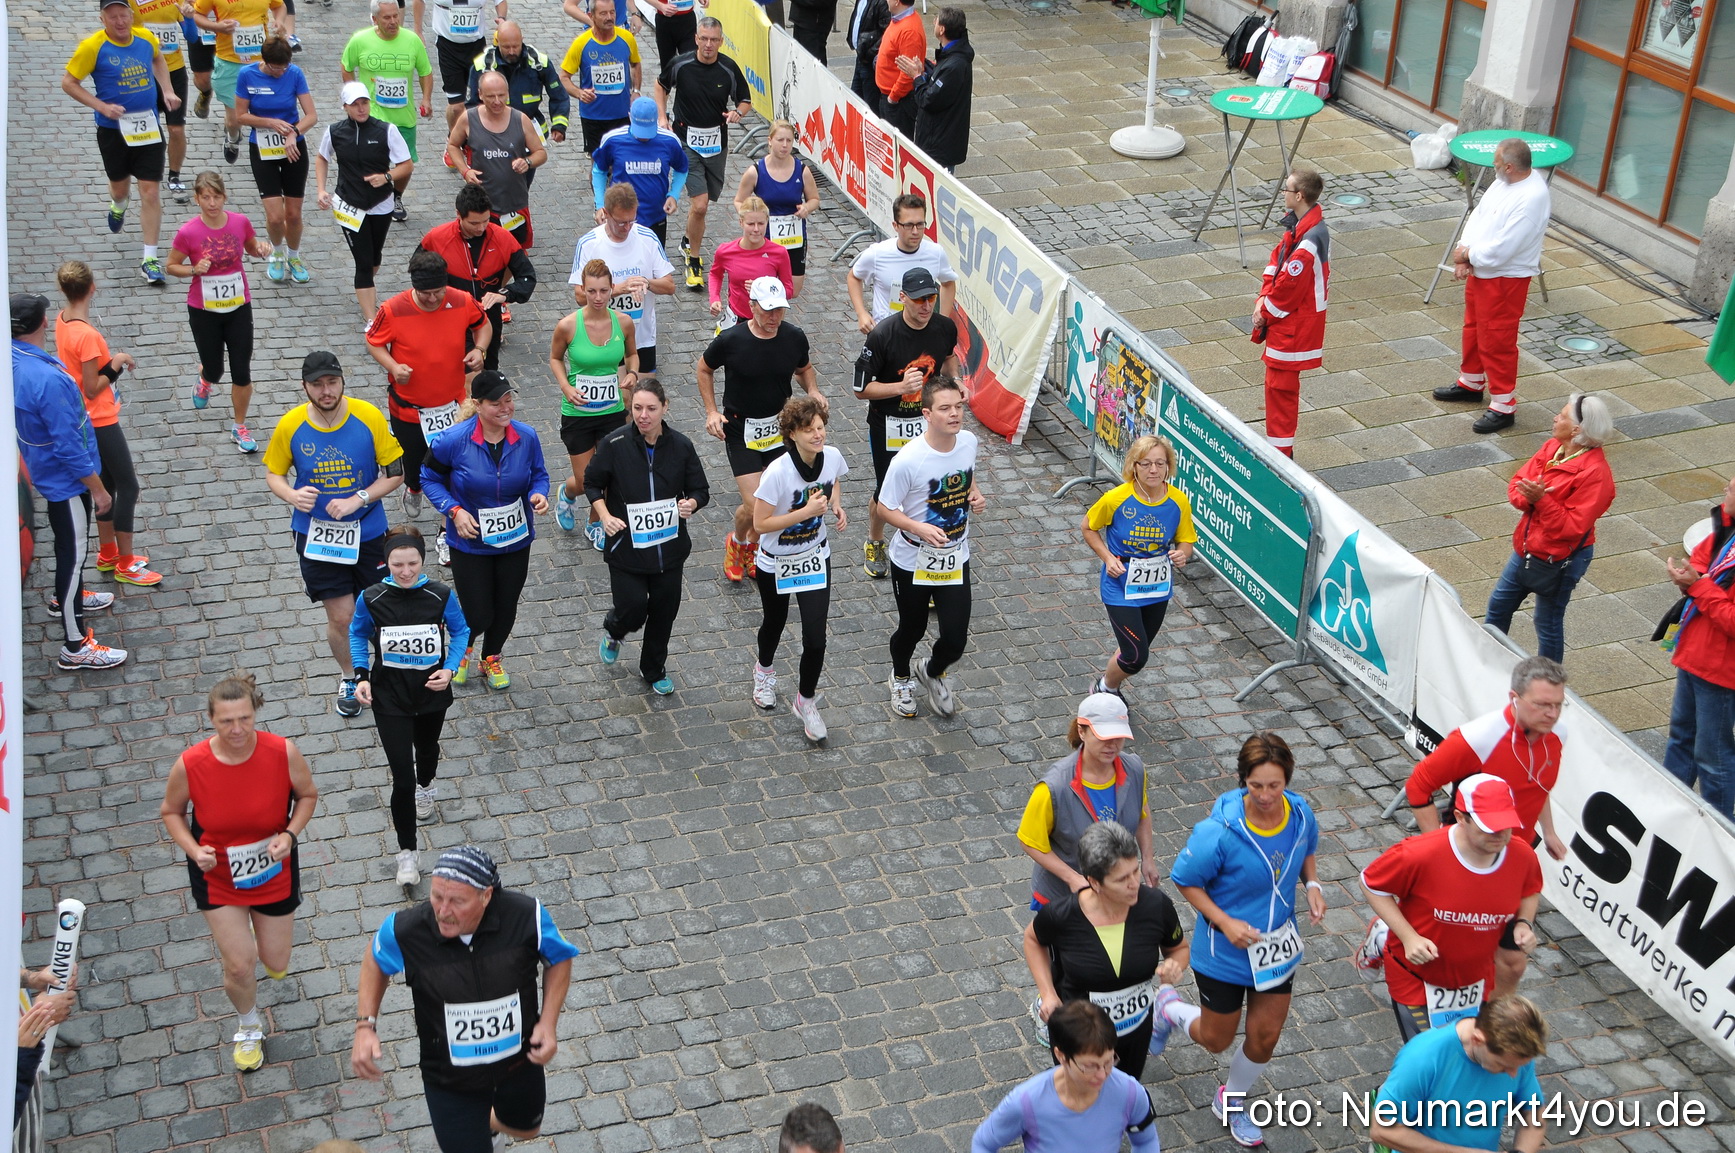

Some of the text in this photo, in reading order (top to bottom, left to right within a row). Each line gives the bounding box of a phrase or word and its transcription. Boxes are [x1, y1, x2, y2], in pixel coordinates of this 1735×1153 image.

[139, 4, 158, 15] MAX
[453, 15, 479, 26] 2077
[237, 34, 264, 46] 2545
[595, 71, 622, 84] 2264
[378, 84, 405, 97] 2323
[132, 120, 147, 133] 73
[691, 134, 719, 147] 2577
[625, 161, 662, 171] HUBER
[845, 149, 866, 190] Braun
[778, 223, 796, 237] 271
[212, 283, 236, 299] 121
[581, 384, 615, 400] 2070
[896, 422, 923, 437] 193
[755, 438, 776, 448] Werner
[1183, 413, 1252, 480] Event-Leit-Systeme
[1193, 466, 1252, 530] Sicherheit
[486, 510, 522, 534] 2504
[634, 510, 673, 531] 2697
[1196, 493, 1234, 543] Event!
[313, 526, 355, 546] 2620
[497, 531, 518, 542] Marion
[647, 532, 664, 541] Britta
[321, 547, 342, 557] Ronny
[781, 556, 822, 578] 2568
[926, 554, 956, 571] 219
[926, 572, 952, 580] Andreas
[1132, 565, 1168, 584] 2113
[1205, 541, 1223, 566] Line:
[1223, 558, 1246, 587] 09181
[1247, 581, 1267, 606] 6352
[793, 578, 811, 586] Karin
[402, 629, 431, 637] Neumarkt
[387, 637, 436, 655] 2336
[399, 656, 424, 665] Selina
[1312, 626, 1388, 692] Gebäude Service GmbH
[251, 873, 270, 886] Gabi
[1559, 865, 1709, 1013] stadtwerke
[1256, 933, 1299, 967] 2291
[1434, 984, 1479, 1010] 2756
[447, 1003, 509, 1017] PARTL Neumarkt
[455, 1011, 516, 1041] 2534
[474, 1044, 499, 1056] Hans
